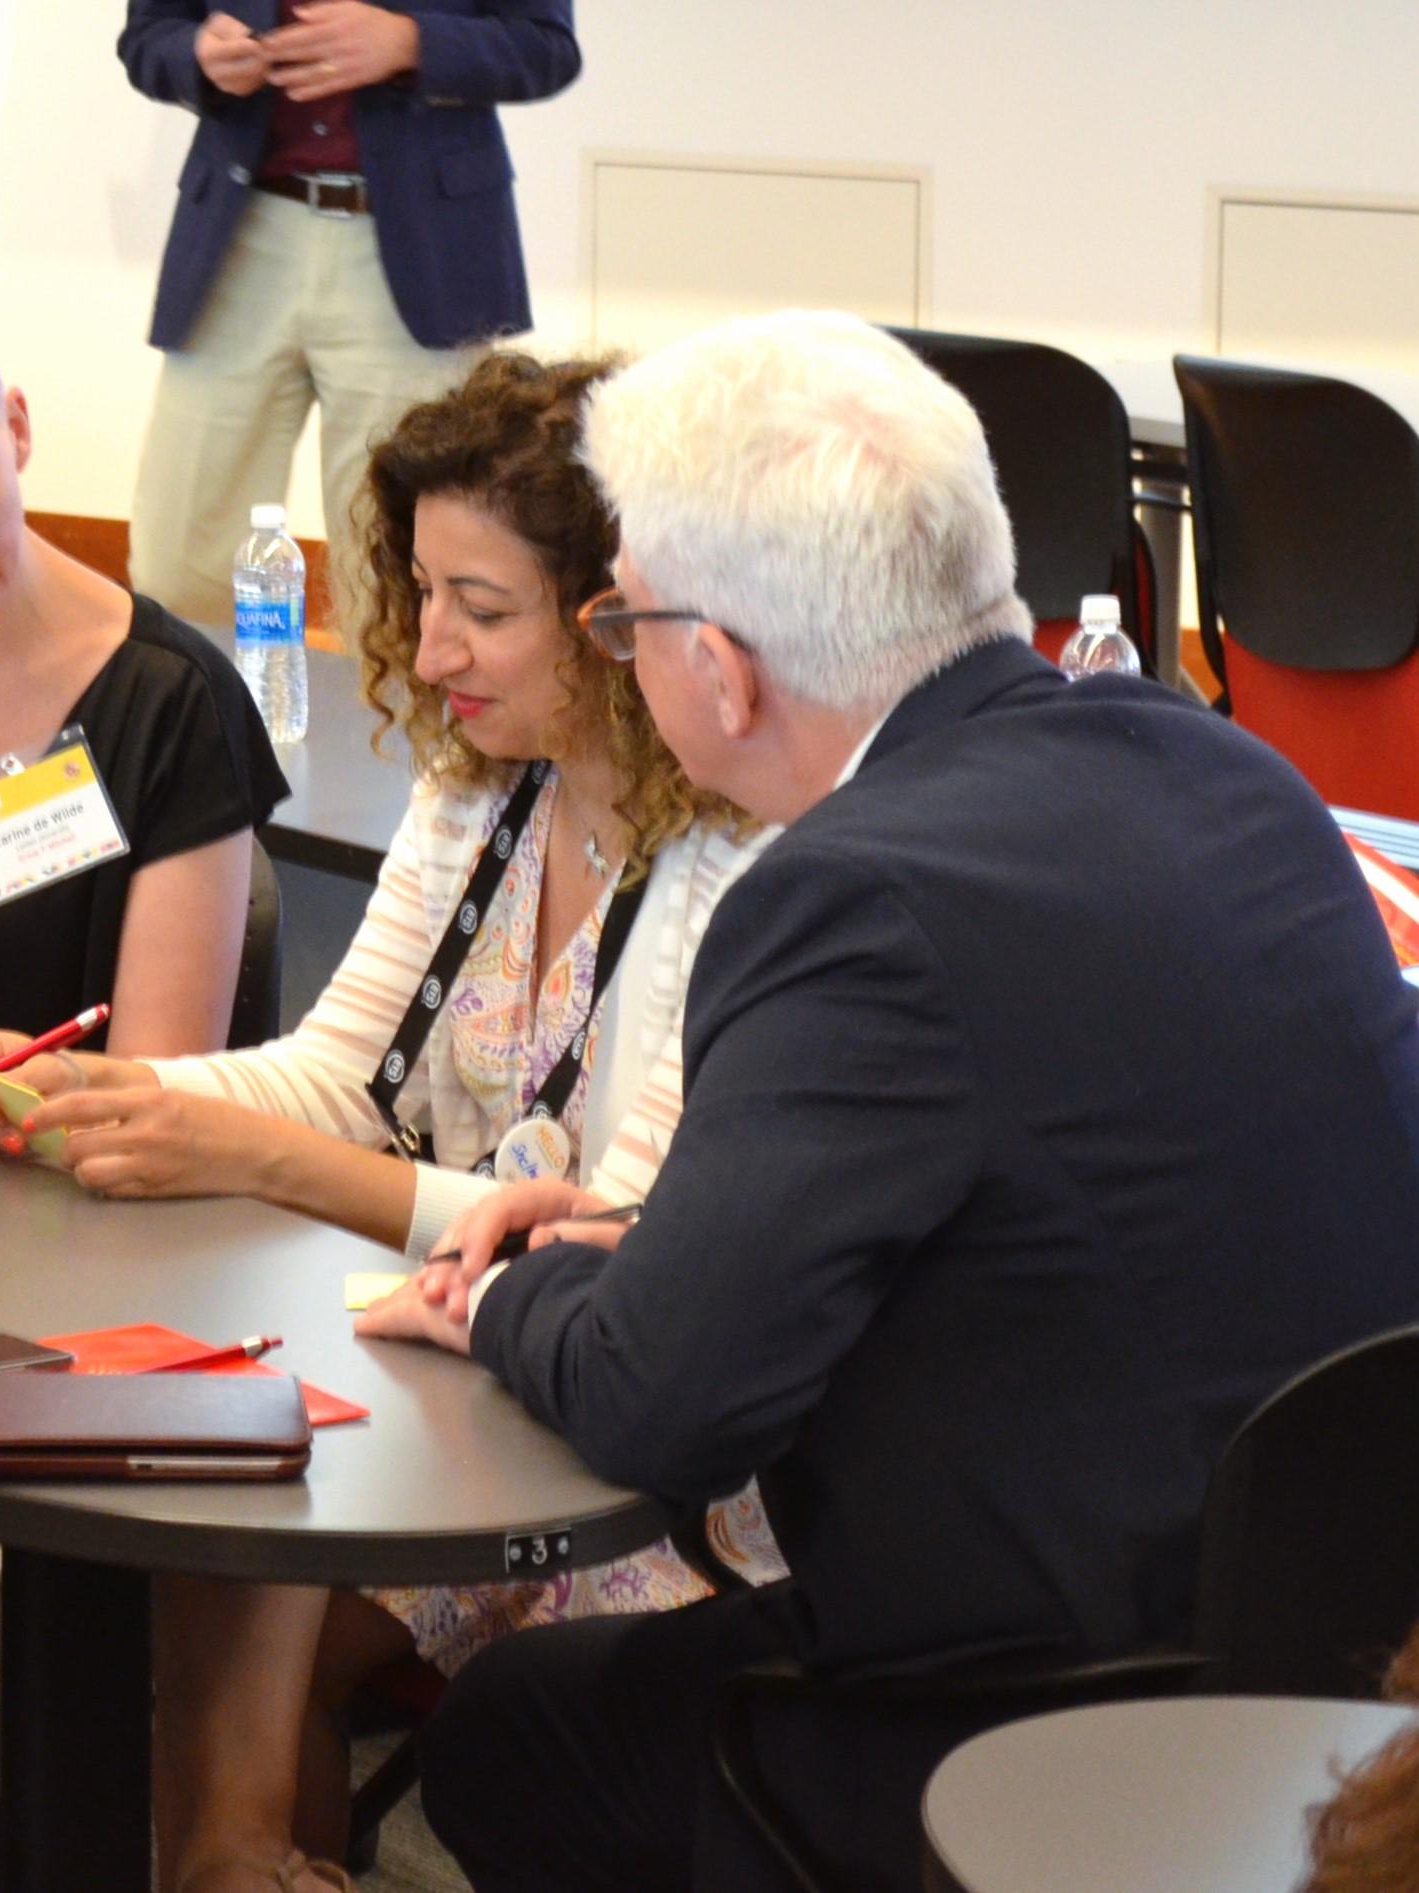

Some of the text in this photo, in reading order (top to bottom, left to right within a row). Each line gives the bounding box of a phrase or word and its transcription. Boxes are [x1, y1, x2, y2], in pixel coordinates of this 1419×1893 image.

[34, 818, 49, 832] de
[51, 803, 84, 823] Wilde
[536, 1126, 565, 1169] HELLO
[532, 1535, 548, 1565] 3
